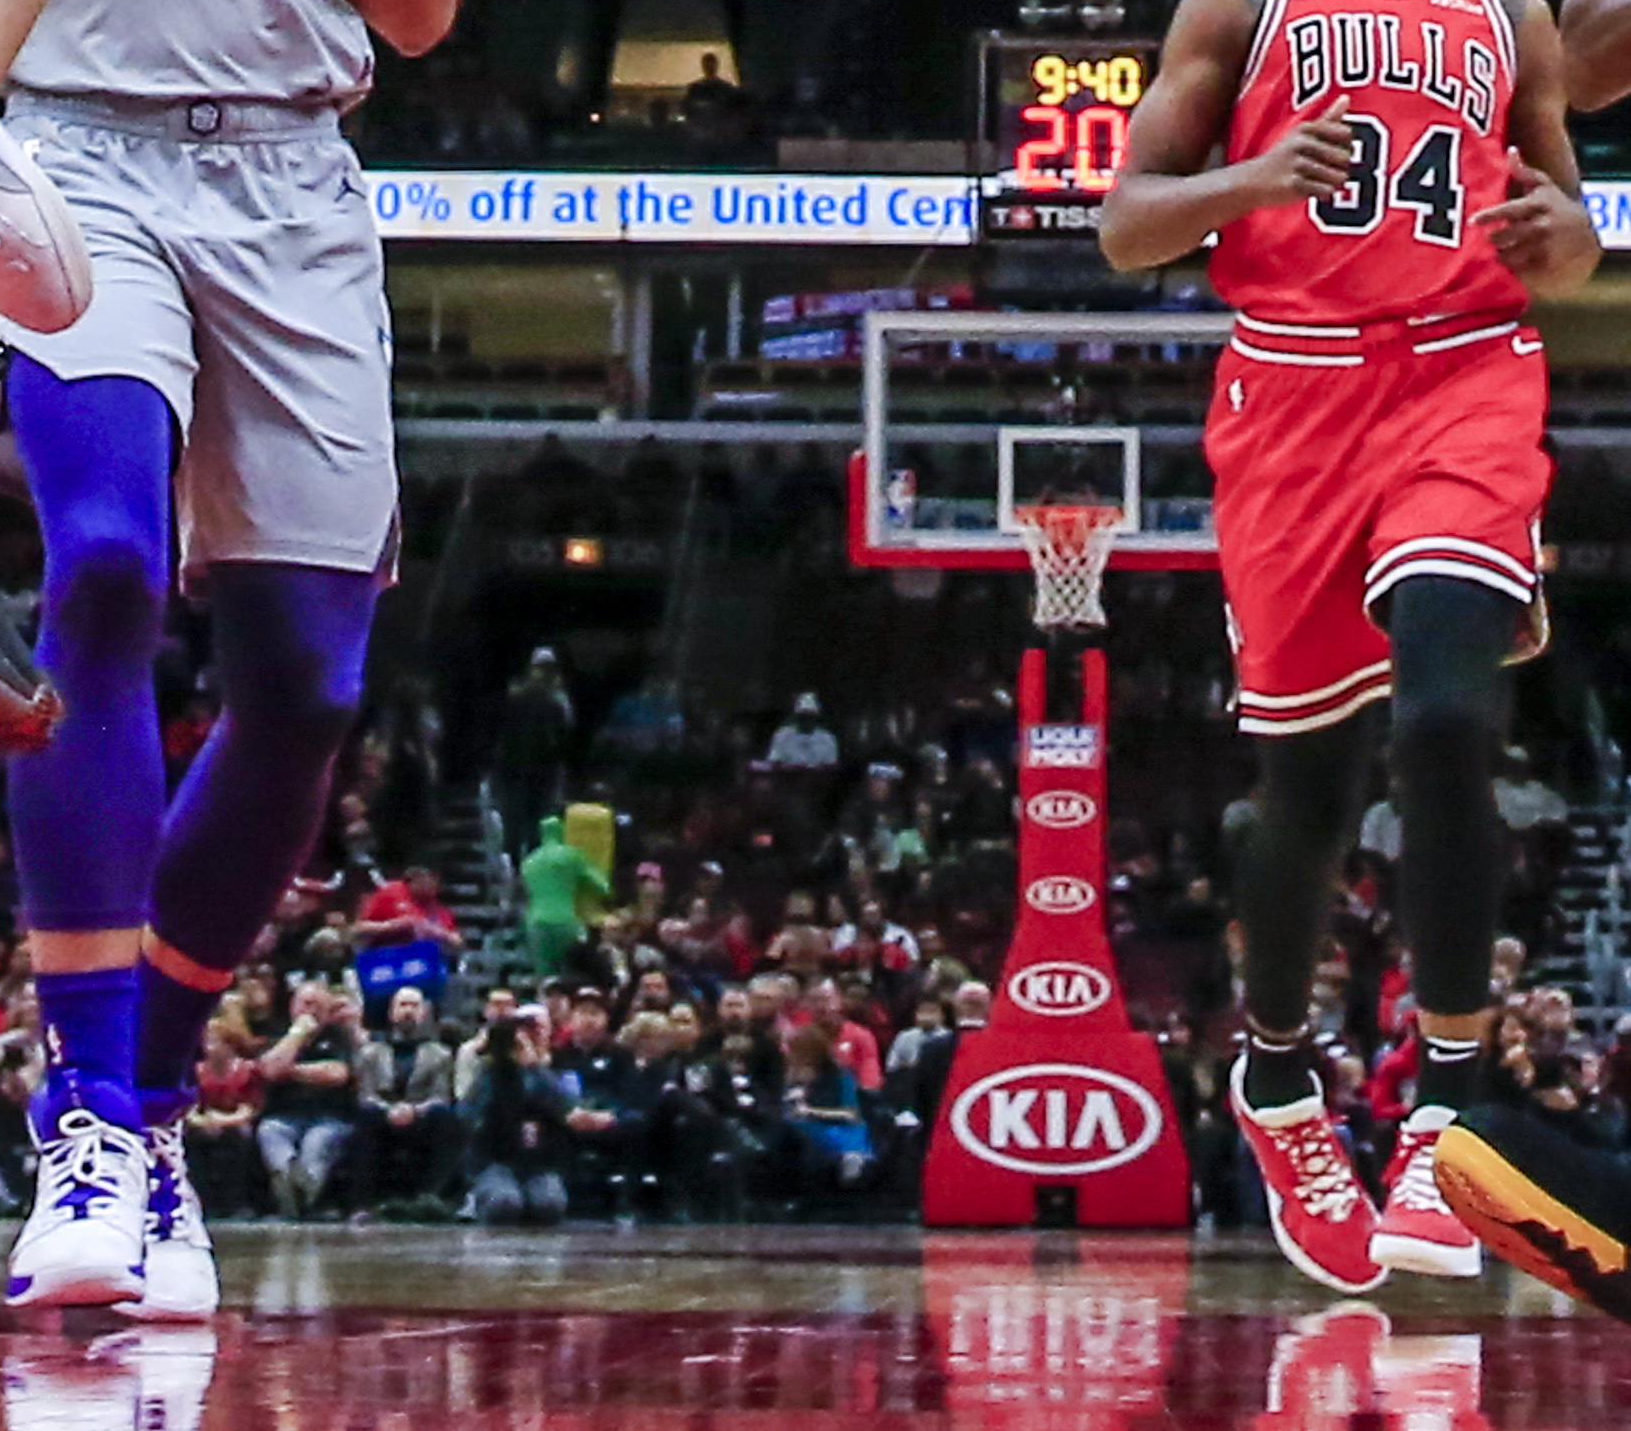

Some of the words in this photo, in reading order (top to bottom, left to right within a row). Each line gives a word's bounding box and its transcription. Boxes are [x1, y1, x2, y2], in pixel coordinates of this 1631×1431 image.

[1033, 54, 1142, 106] 9:40
[1286, 12, 1497, 136] BULLS
[1015, 106, 1129, 192] 20
[377, 182, 451, 221] 0%
[471, 178, 538, 222] off
[553, 185, 599, 222] at
[617, 181, 694, 224] the
[713, 182, 868, 226] United
[888, 188, 973, 227] Cen
[1308, 113, 1464, 248] 34
[1034, 205, 1107, 230] TISS
[988, 1089, 1126, 1150] KIA
